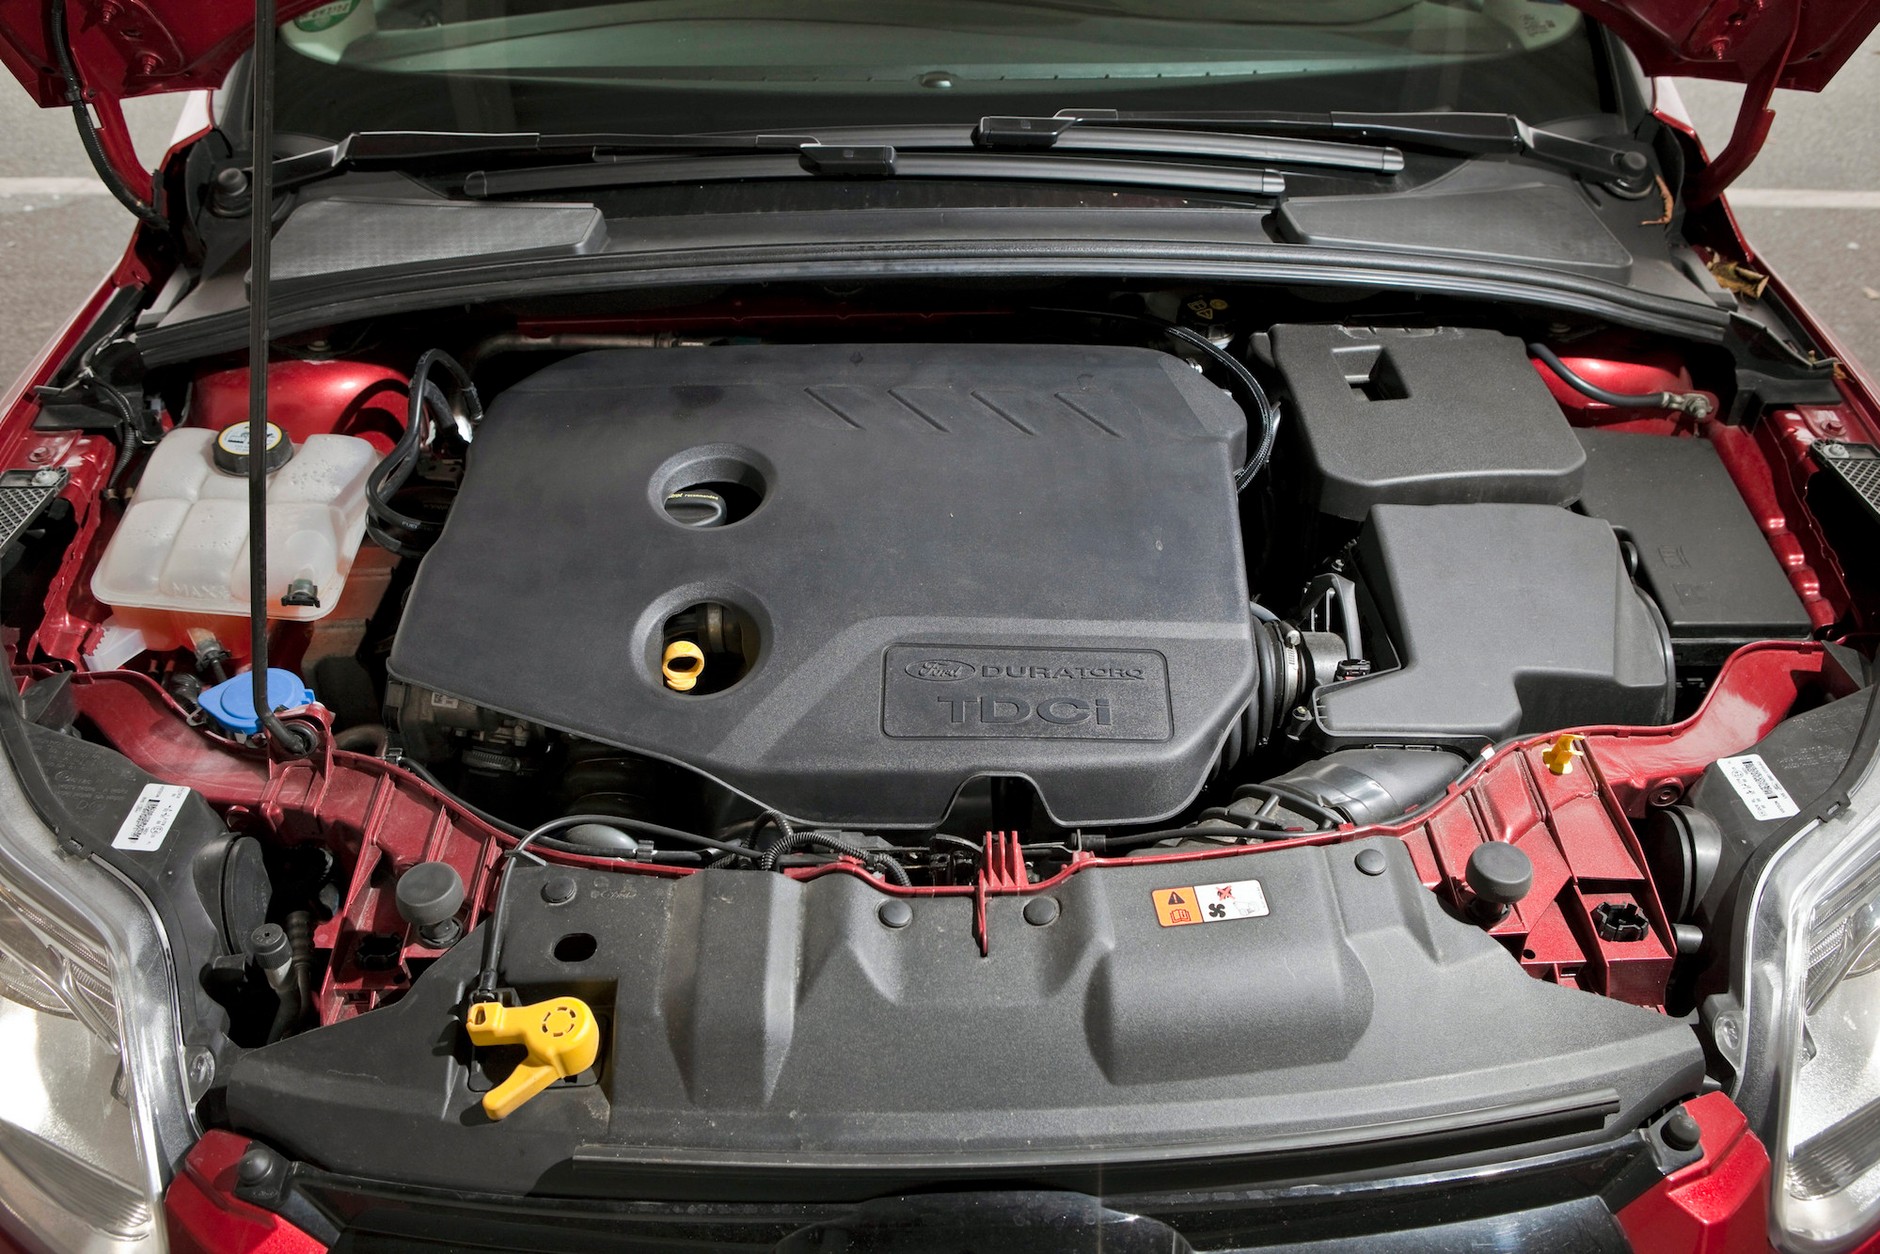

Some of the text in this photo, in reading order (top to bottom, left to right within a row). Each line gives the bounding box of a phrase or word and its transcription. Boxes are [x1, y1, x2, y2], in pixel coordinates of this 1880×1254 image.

[918, 662, 1146, 681] Ford DURATORQ
[937, 696, 1112, 725] TDCi
